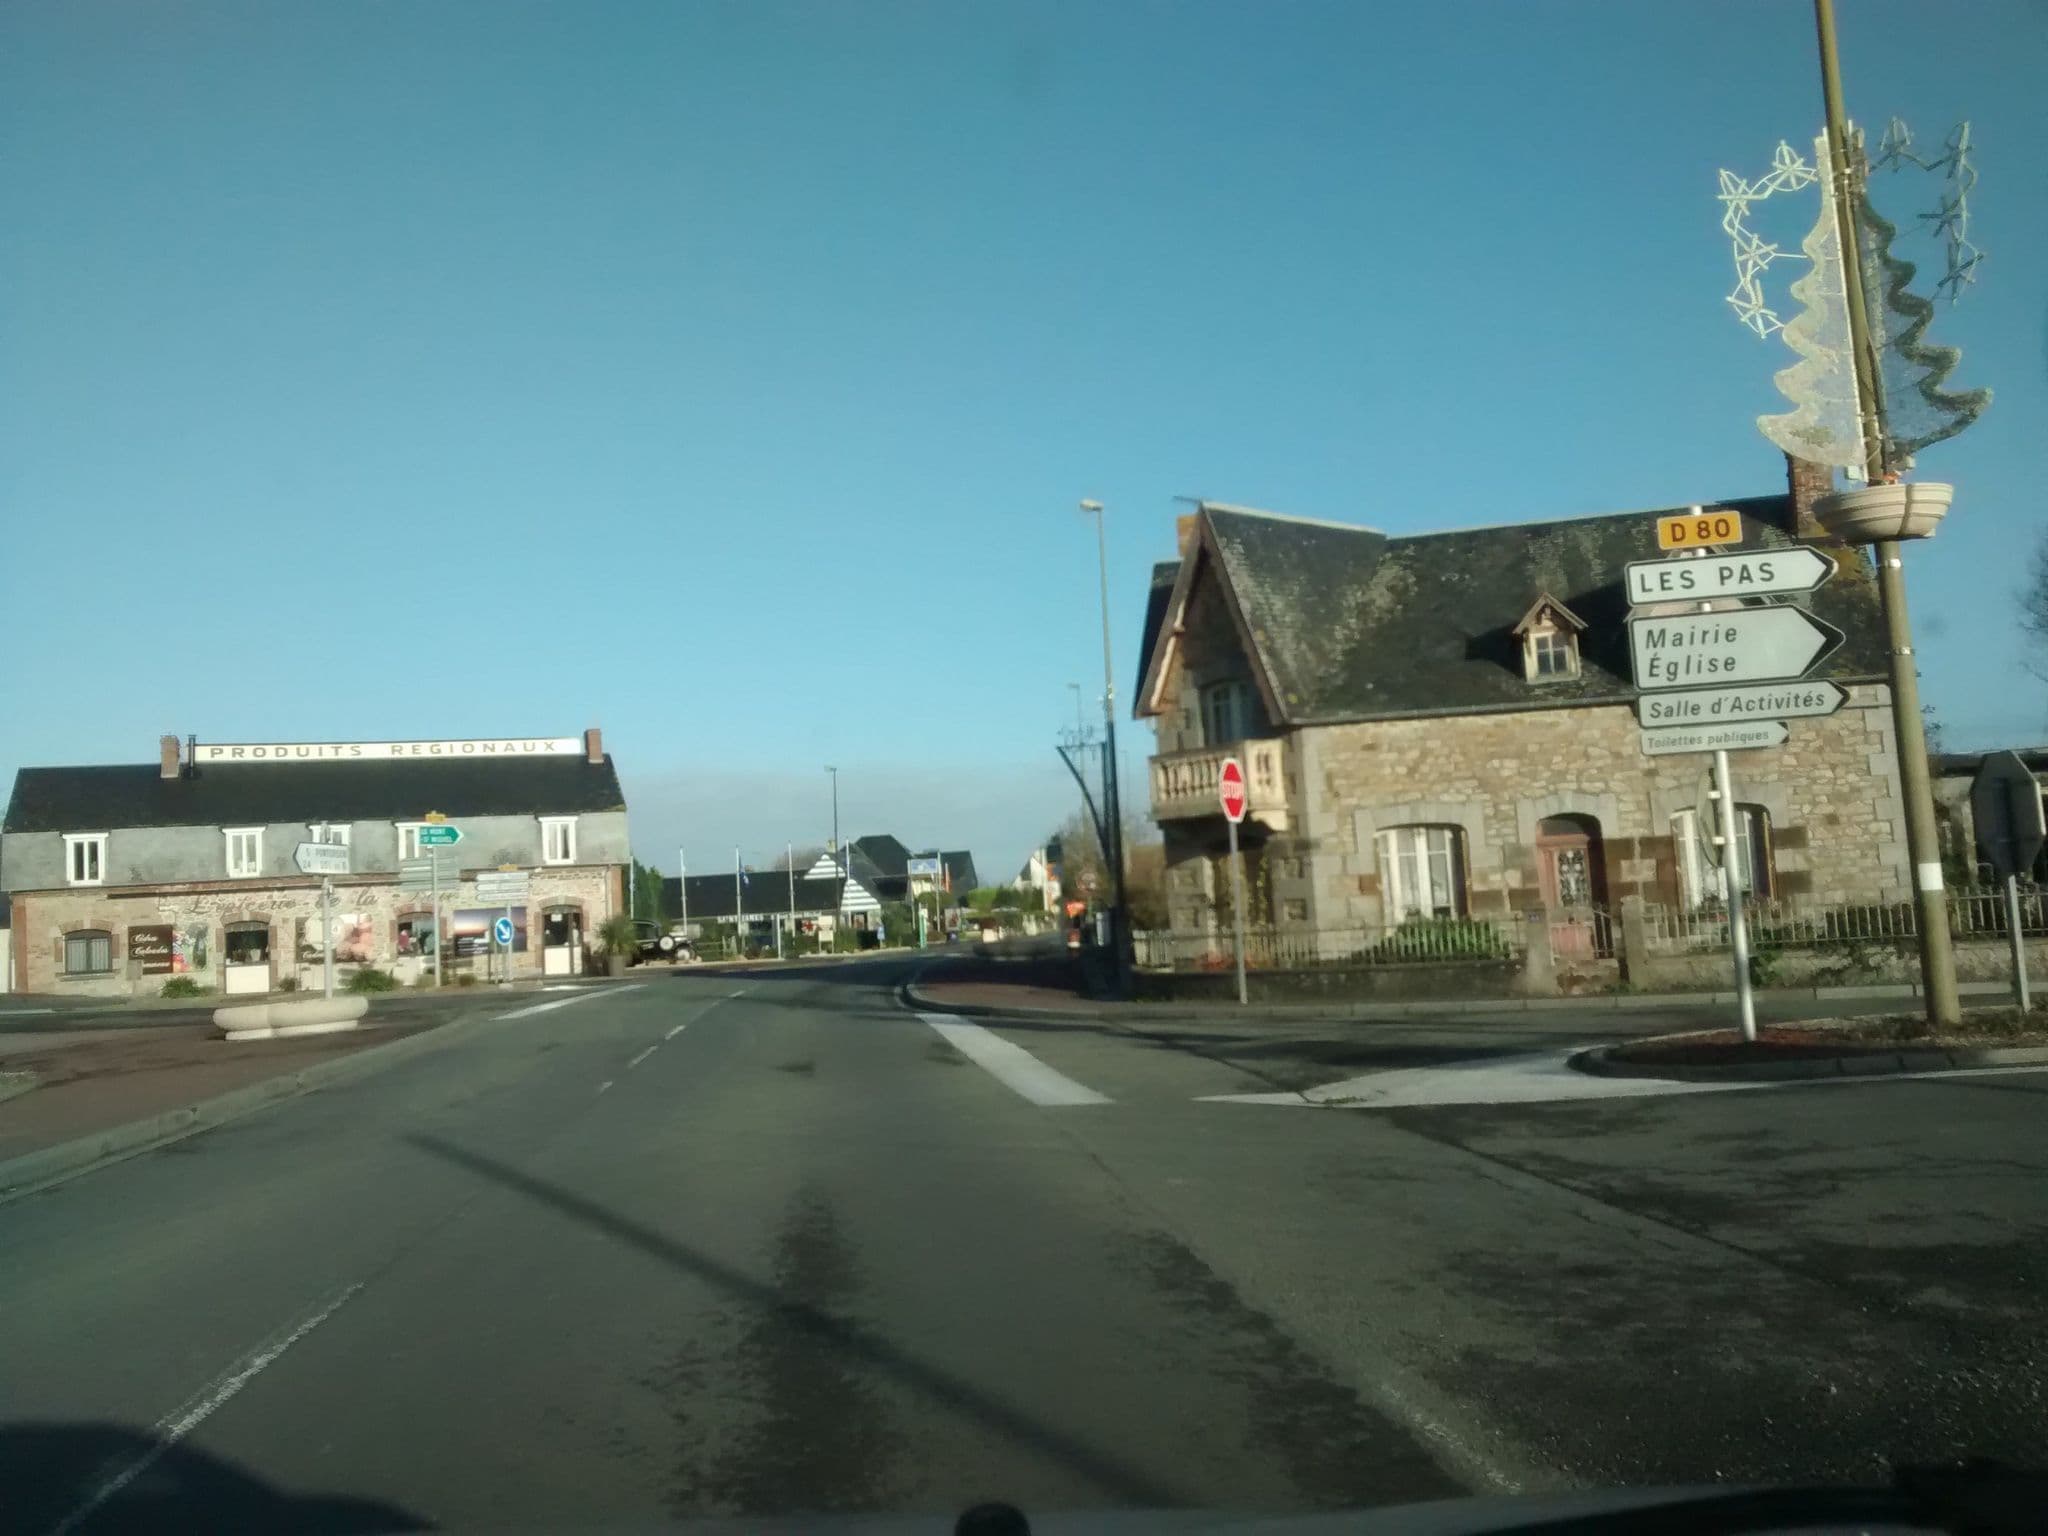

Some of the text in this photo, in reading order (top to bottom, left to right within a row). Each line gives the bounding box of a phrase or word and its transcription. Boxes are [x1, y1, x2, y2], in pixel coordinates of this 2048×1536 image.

[1670, 518, 1731, 543] D 80
[1639, 562, 1776, 594] LES PAS
[1645, 623, 1738, 649] Mairie
[1648, 652, 1737, 682] Église
[1649, 691, 1826, 719] Salle d'Activités
[209, 741, 556, 759] PRODUITS REGIONAUX
[1647, 731, 1770, 749] Toilettes publiques
[1221, 781, 1245, 799] STOP
